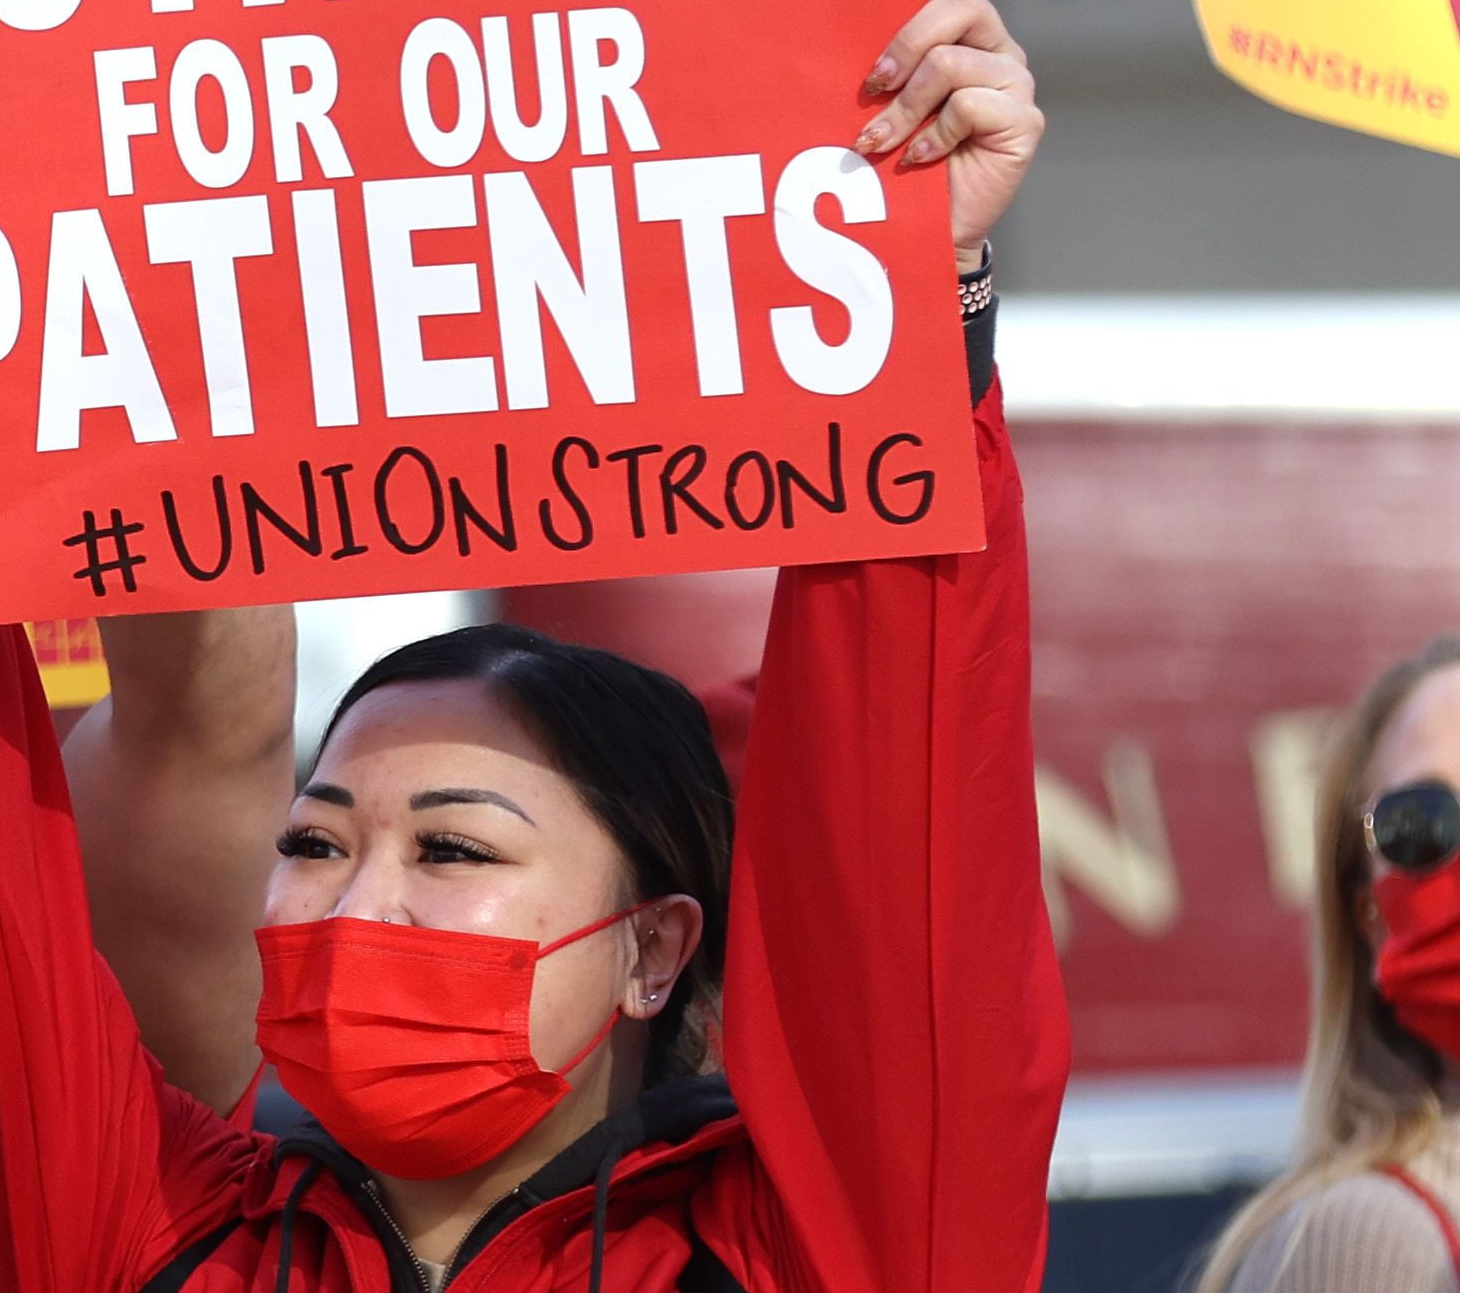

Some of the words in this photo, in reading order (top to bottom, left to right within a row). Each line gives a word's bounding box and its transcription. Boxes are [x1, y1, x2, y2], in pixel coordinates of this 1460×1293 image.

[93, 33, 355, 197] FOR
[400, 6, 660, 167] OUR
[1227, 22, 1450, 120] #RNStrike
